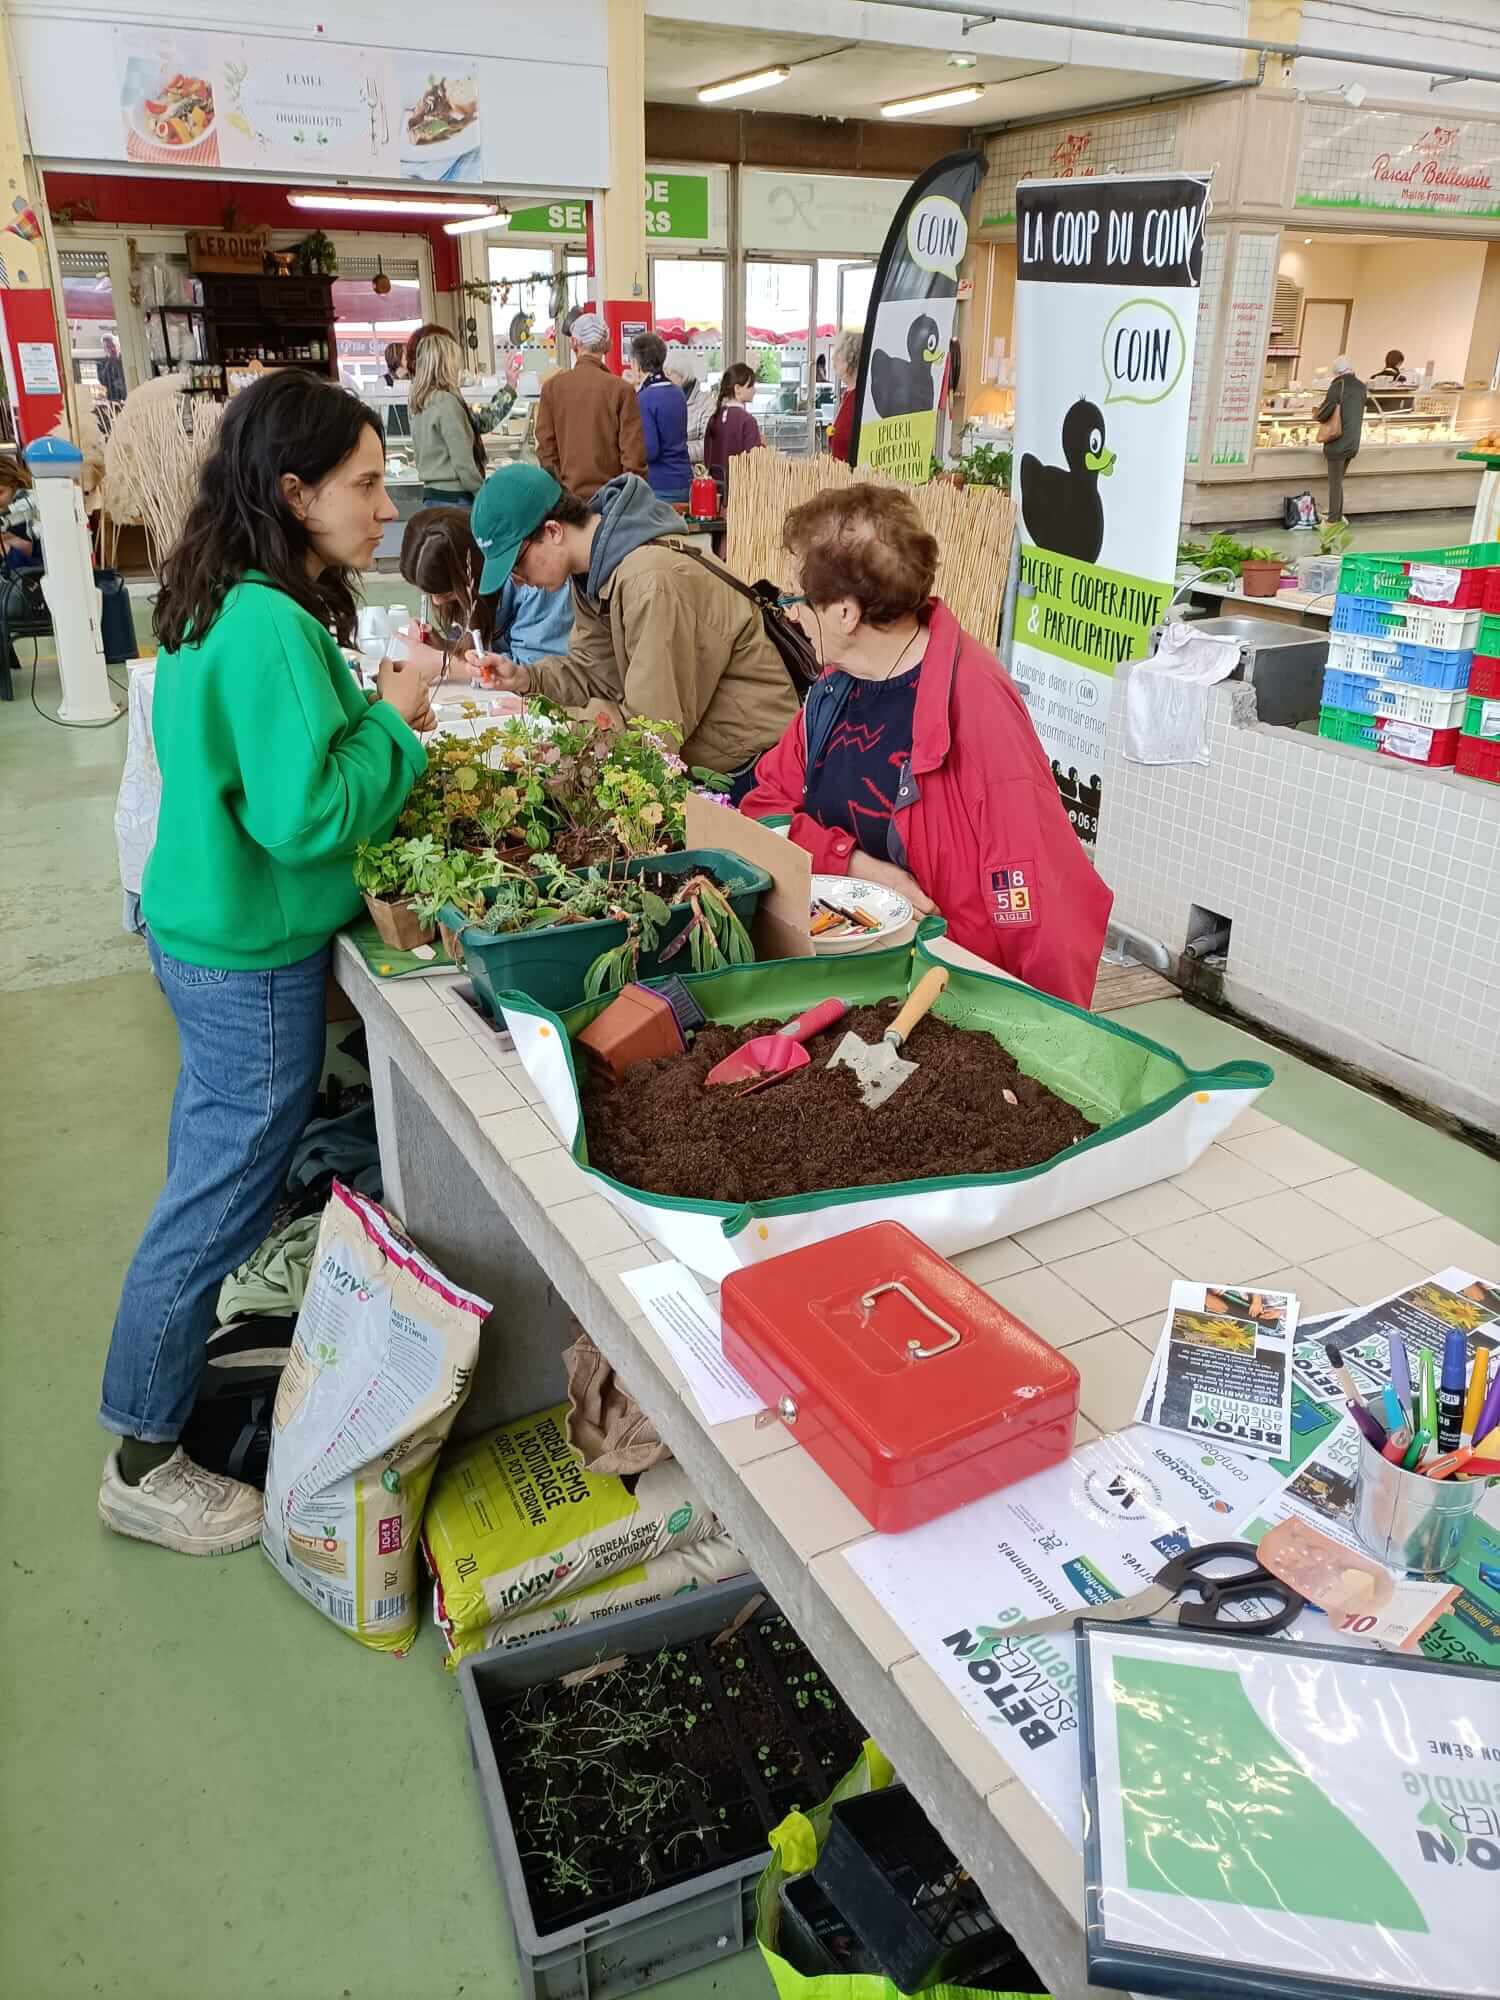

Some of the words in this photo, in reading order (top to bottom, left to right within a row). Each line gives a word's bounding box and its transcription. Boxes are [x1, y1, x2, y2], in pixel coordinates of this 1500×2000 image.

[916, 211, 959, 258] COIN
[1023, 209, 1044, 264] LA
[1052, 209, 1099, 266] COOP
[1107, 210, 1135, 266] DU
[1143, 206, 1199, 269] COIN
[1113, 328, 1171, 383] COIN
[1071, 570, 1162, 627] COOPERATIVE
[1027, 604, 1039, 634] &
[1043, 607, 1135, 664] PARTICIPATIVE
[1193, 1394, 1283, 1421] ensemble
[513, 1427, 528, 1442] &
[518, 1434, 567, 1510] BOUTURAGE
[534, 1417, 566, 1464] TERREAU
[560, 1460, 592, 1504] SEMIS
[1153, 1448, 1214, 1502] fondation
[506, 1457, 520, 1479] POT
[518, 1482, 548, 1527] TERRINE
[589, 1527, 632, 1559] TERREAU
[631, 1520, 659, 1541] SEMIS
[594, 1558, 603, 1569] &
[603, 1532, 659, 1567] BOUTURAGE
[384, 1568, 399, 1592] 20L
[455, 1552, 480, 1583] 20L
[1082, 1586, 1104, 1608] oire
[1340, 1613, 1378, 1633] 10
[1427, 1740, 1474, 1761] SÈME
